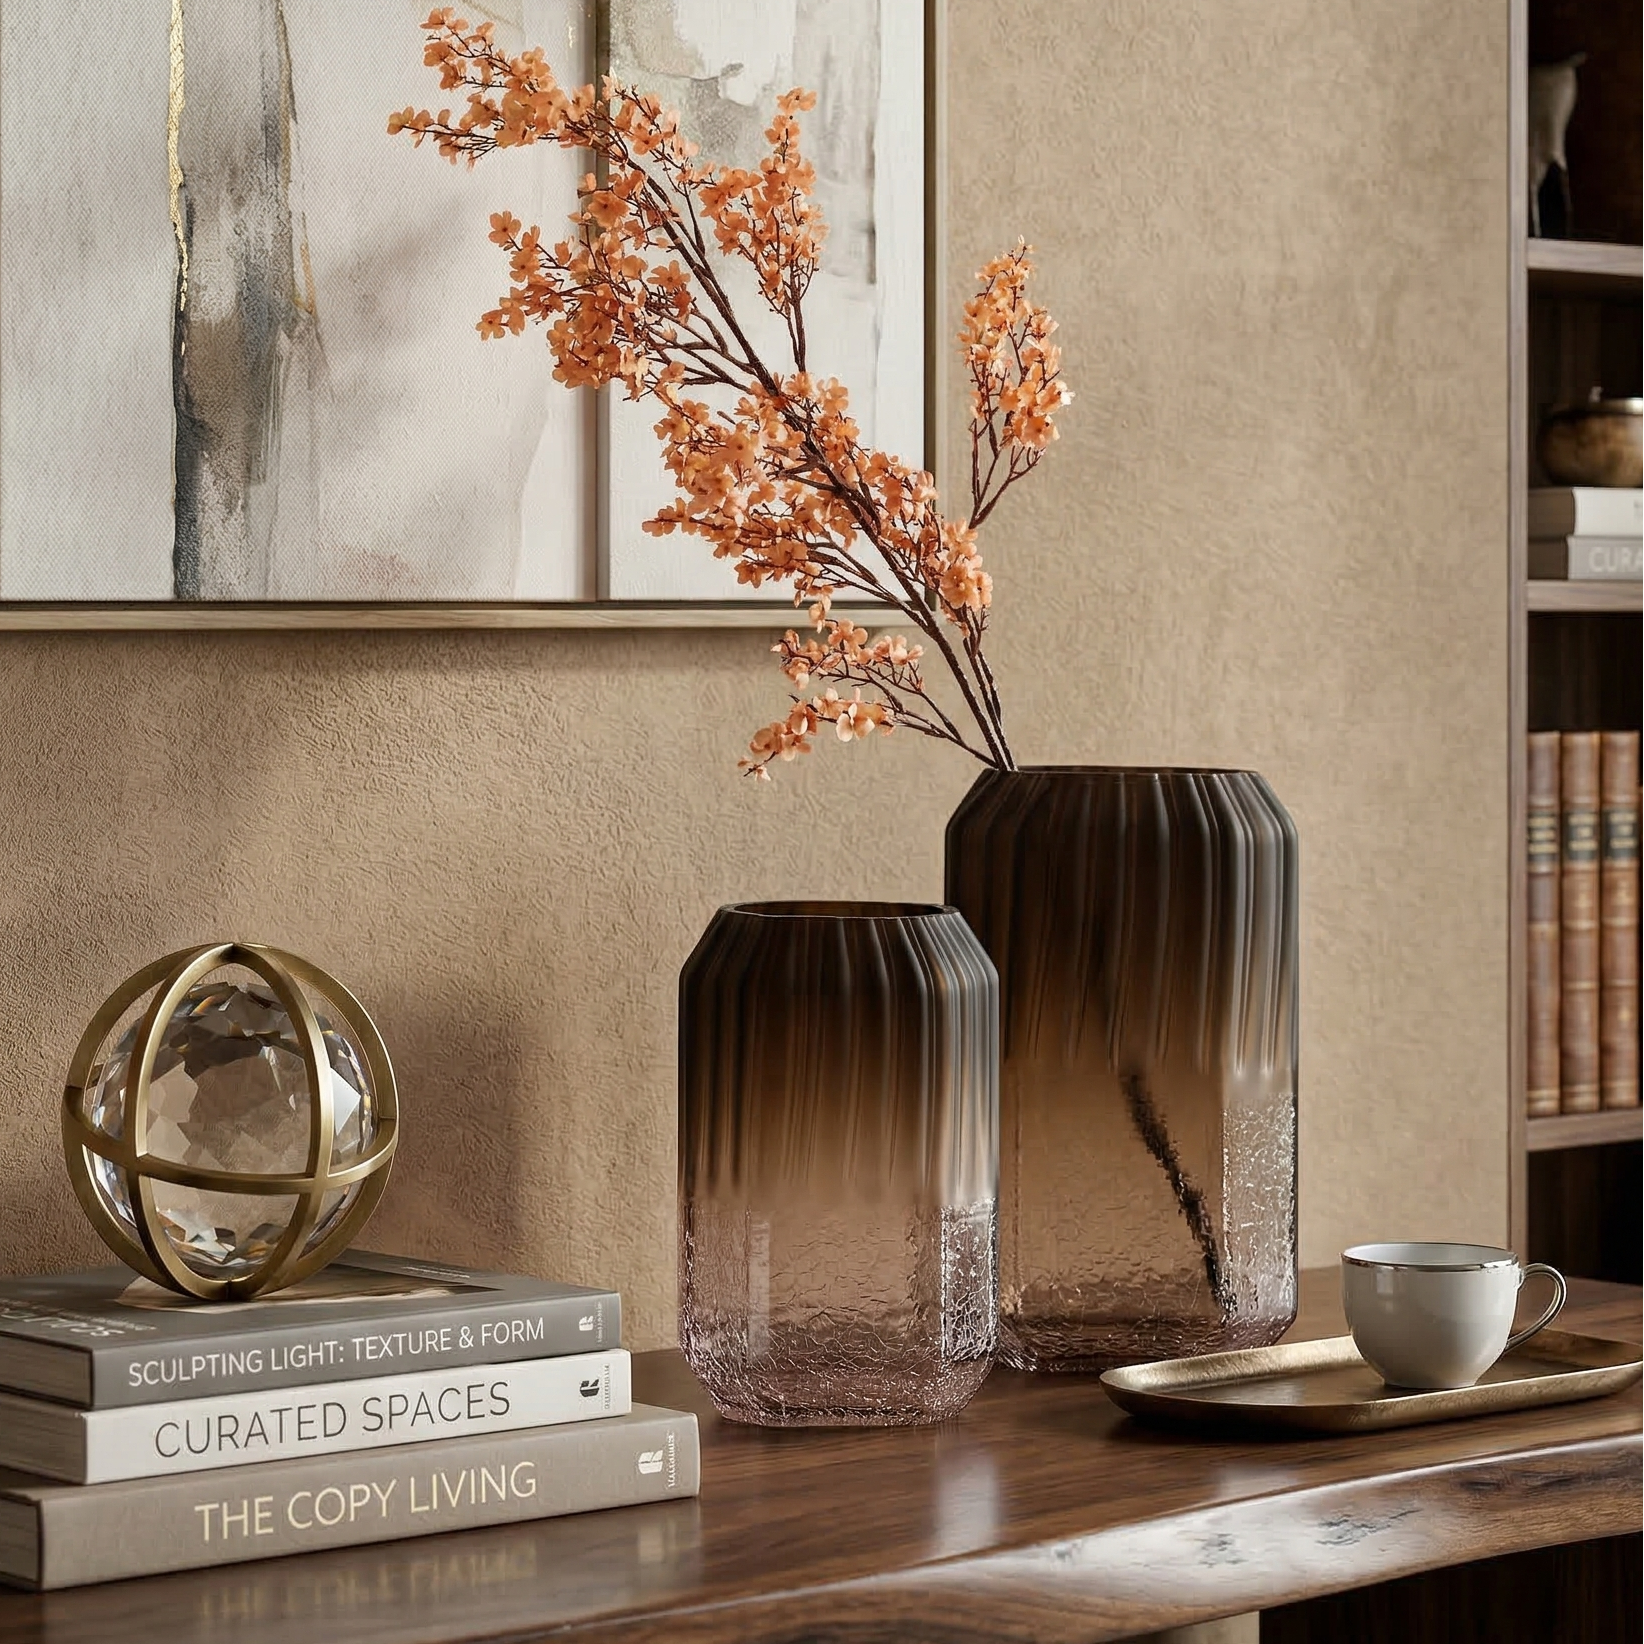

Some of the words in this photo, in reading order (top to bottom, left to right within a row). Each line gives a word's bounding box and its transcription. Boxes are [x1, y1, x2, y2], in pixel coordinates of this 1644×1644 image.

[128, 1349, 264, 1387] SCULPTING
[271, 1340, 345, 1371] LIGHT:
[352, 1328, 452, 1361] TEXTURE
[458, 1325, 474, 1349] &
[481, 1316, 545, 1347] FORM
[154, 1401, 348, 1458] CURATED
[361, 1381, 511, 1432] SPACES
[194, 1495, 274, 1542] THE
[287, 1478, 397, 1529] COPY
[410, 1461, 537, 1513] LIVING
